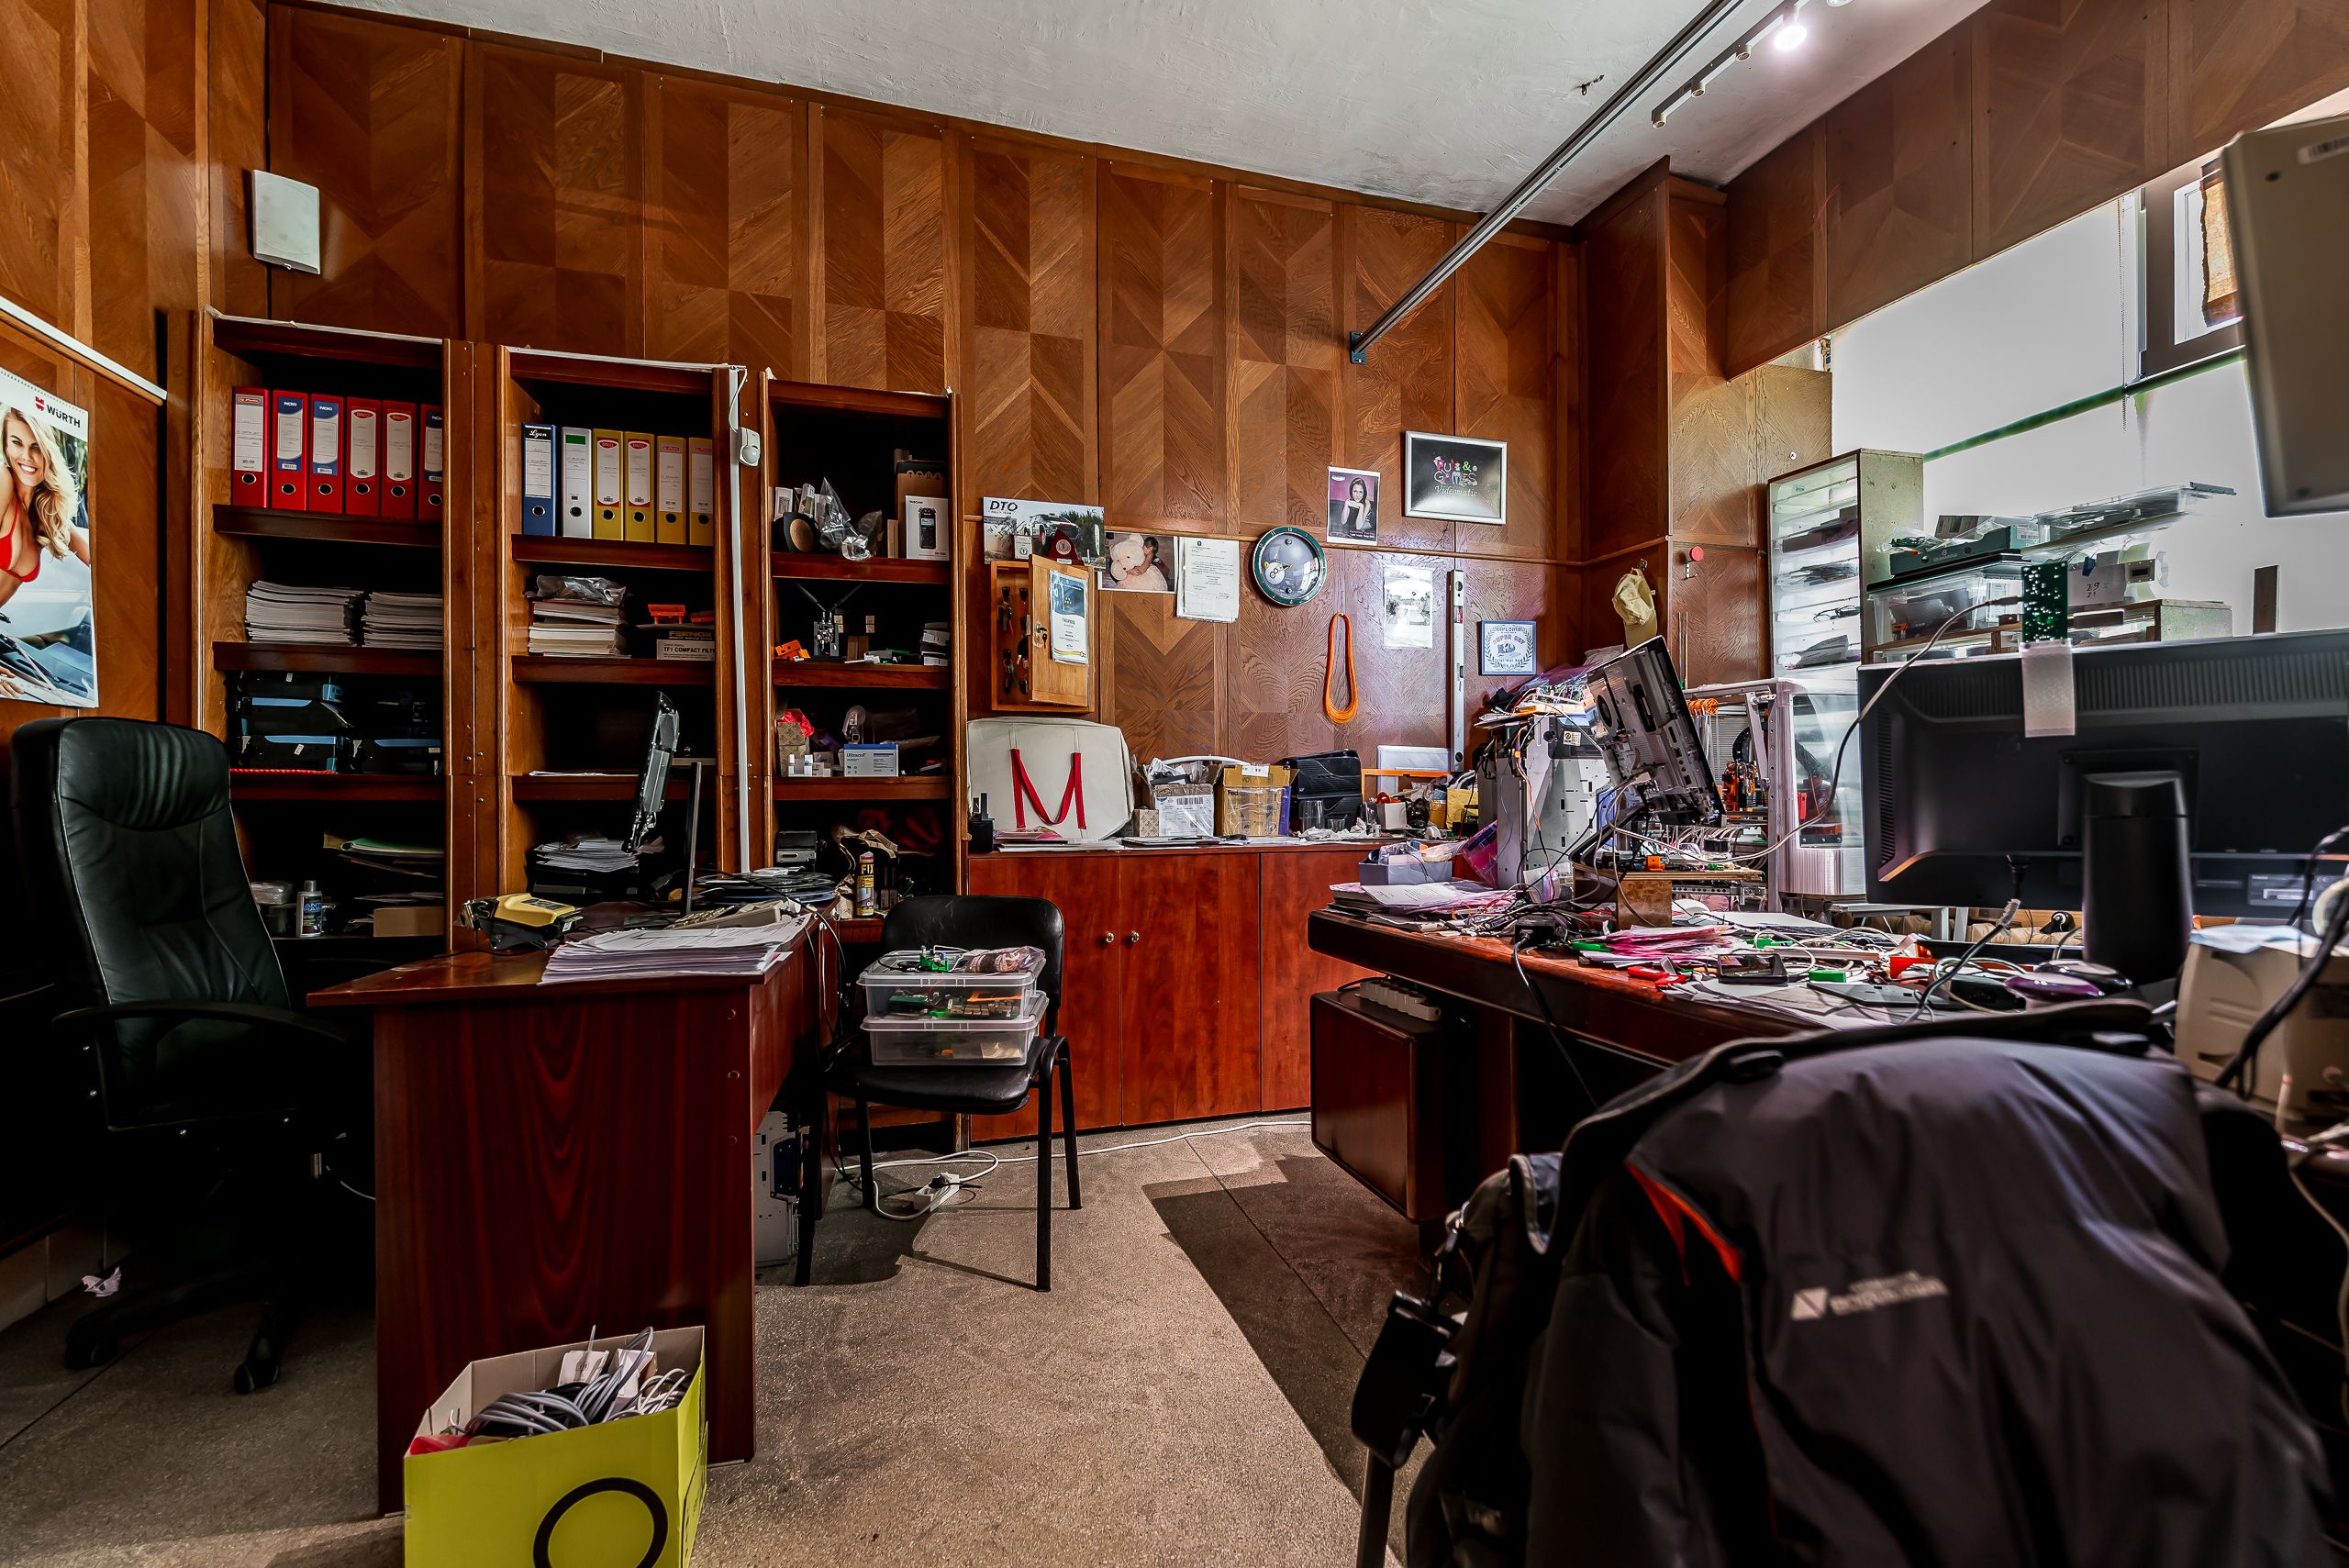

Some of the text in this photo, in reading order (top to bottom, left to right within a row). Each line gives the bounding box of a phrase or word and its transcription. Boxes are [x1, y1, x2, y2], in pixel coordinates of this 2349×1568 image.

[47, 405, 81, 428] WÜRTH
[529, 429, 547, 439] Lyon
[1463, 461, 1472, 473] &
[1434, 484, 1478, 497] Videomatic
[989, 500, 1018, 511] DTO
